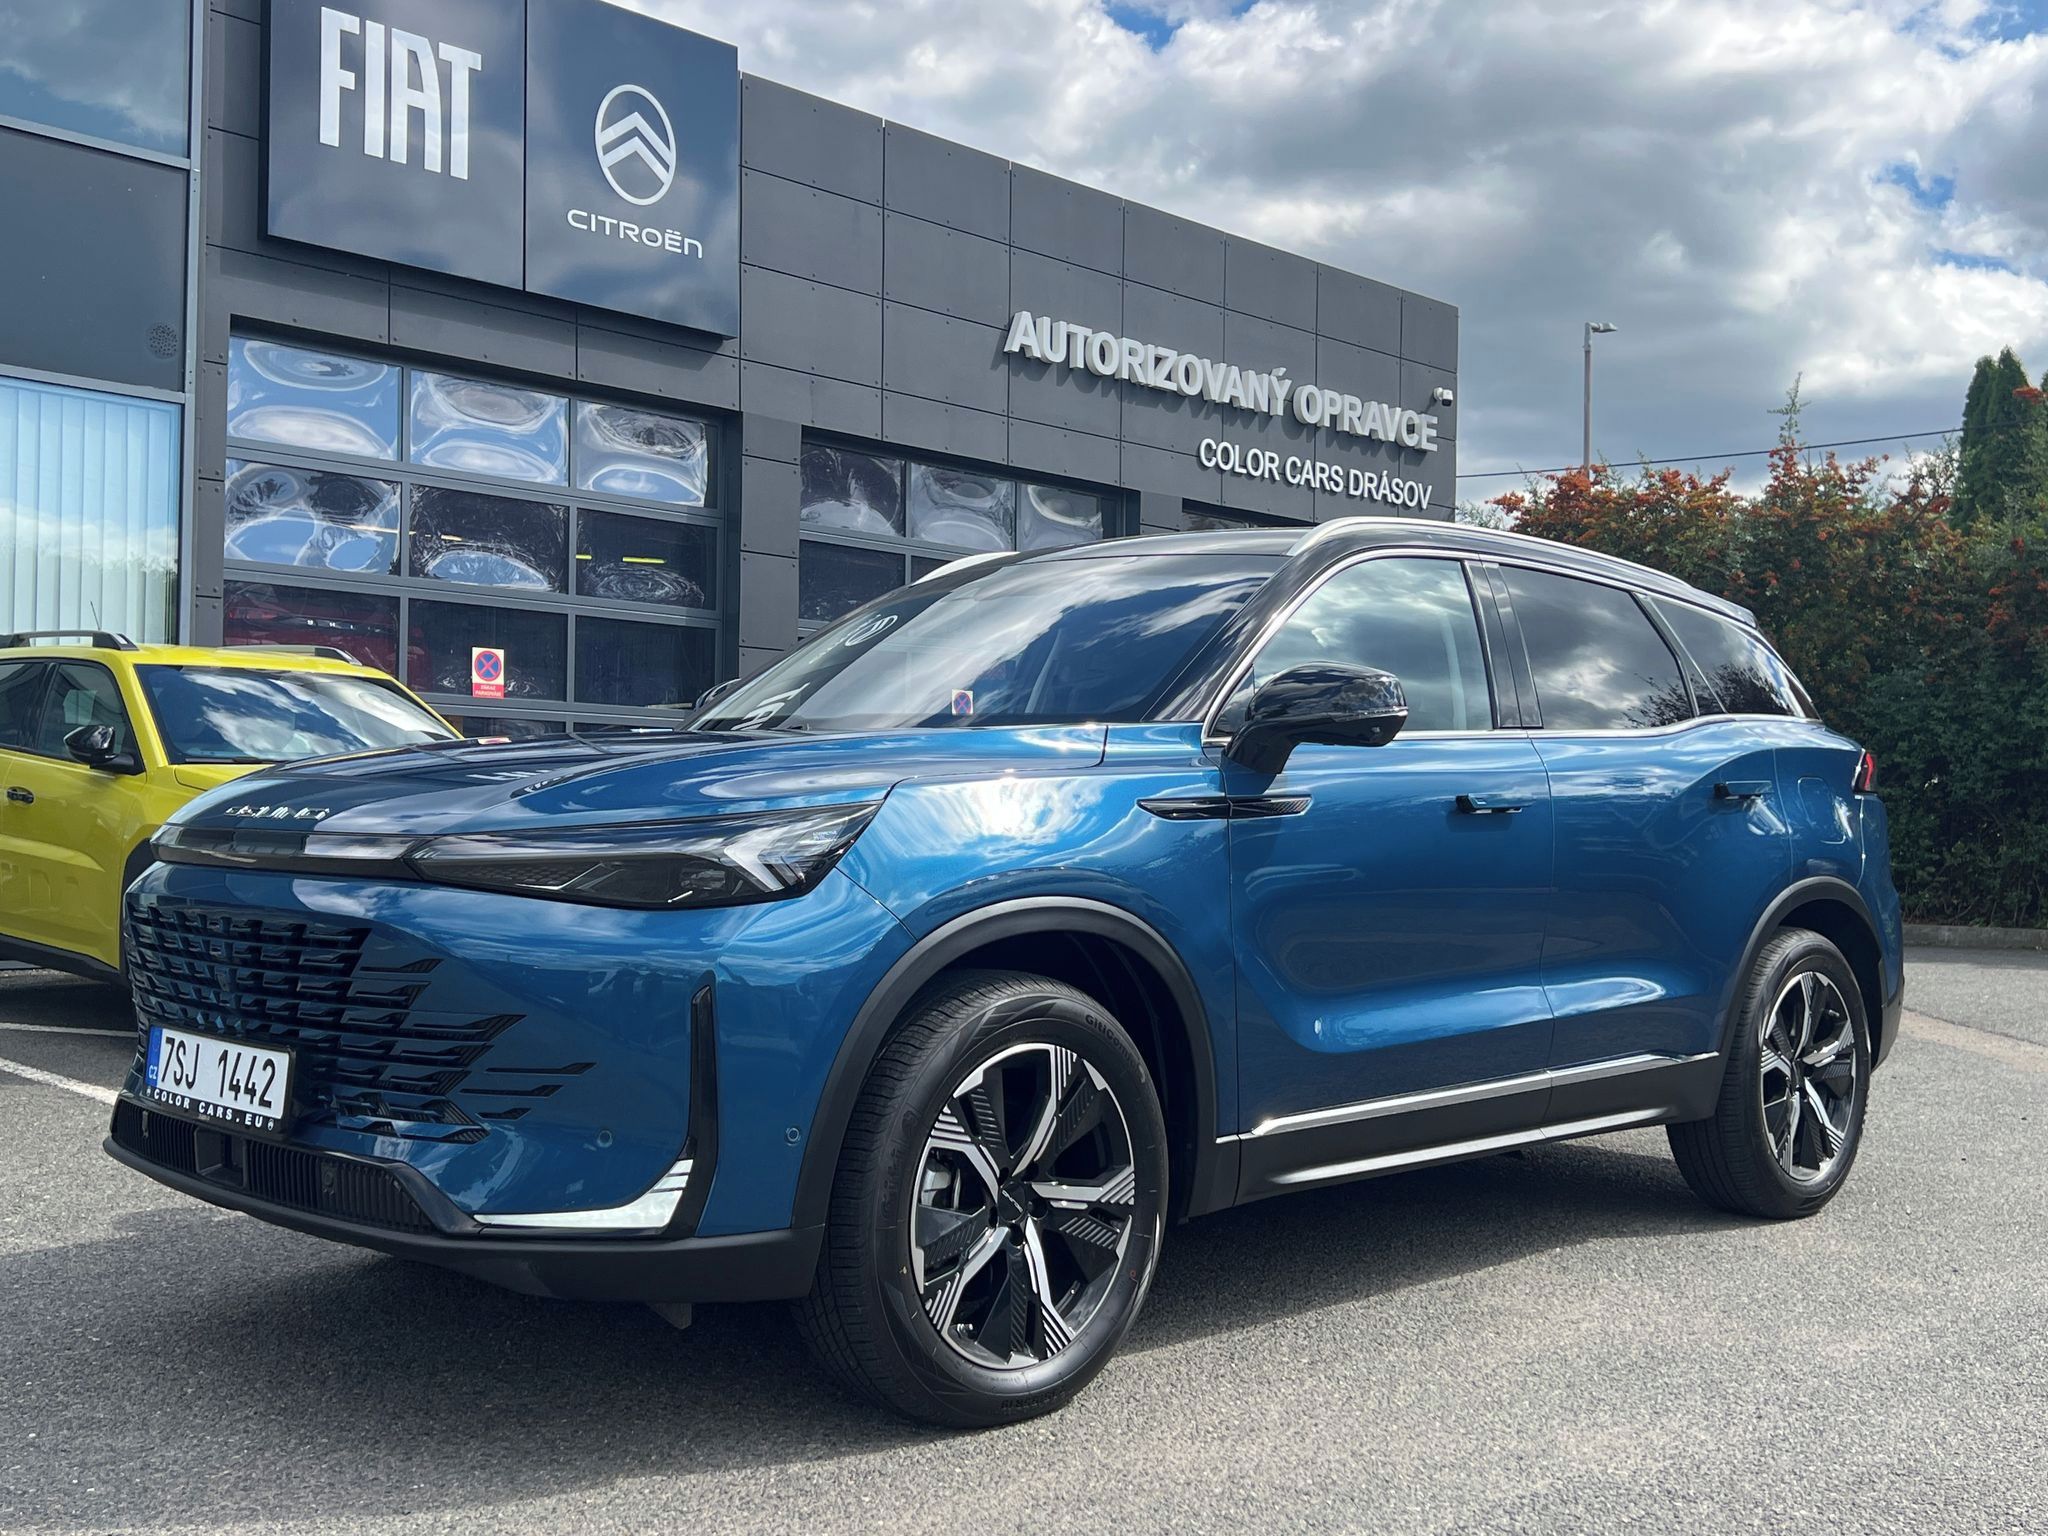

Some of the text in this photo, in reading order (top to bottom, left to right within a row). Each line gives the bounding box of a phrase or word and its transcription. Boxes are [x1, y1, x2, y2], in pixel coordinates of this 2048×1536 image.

[319, 6, 482, 180] FIAT
[566, 208, 703, 260] CITROËN
[1003, 310, 1439, 453] AUTORIZOVANÝ OPRAVCE
[1199, 437, 1433, 510] COLOR CARS DRÁSOV
[148, 1064, 159, 1080] CZ
[153, 1088, 264, 1128] COLOR CARS.EU
[161, 1036, 276, 1109] 7SJ 1442
